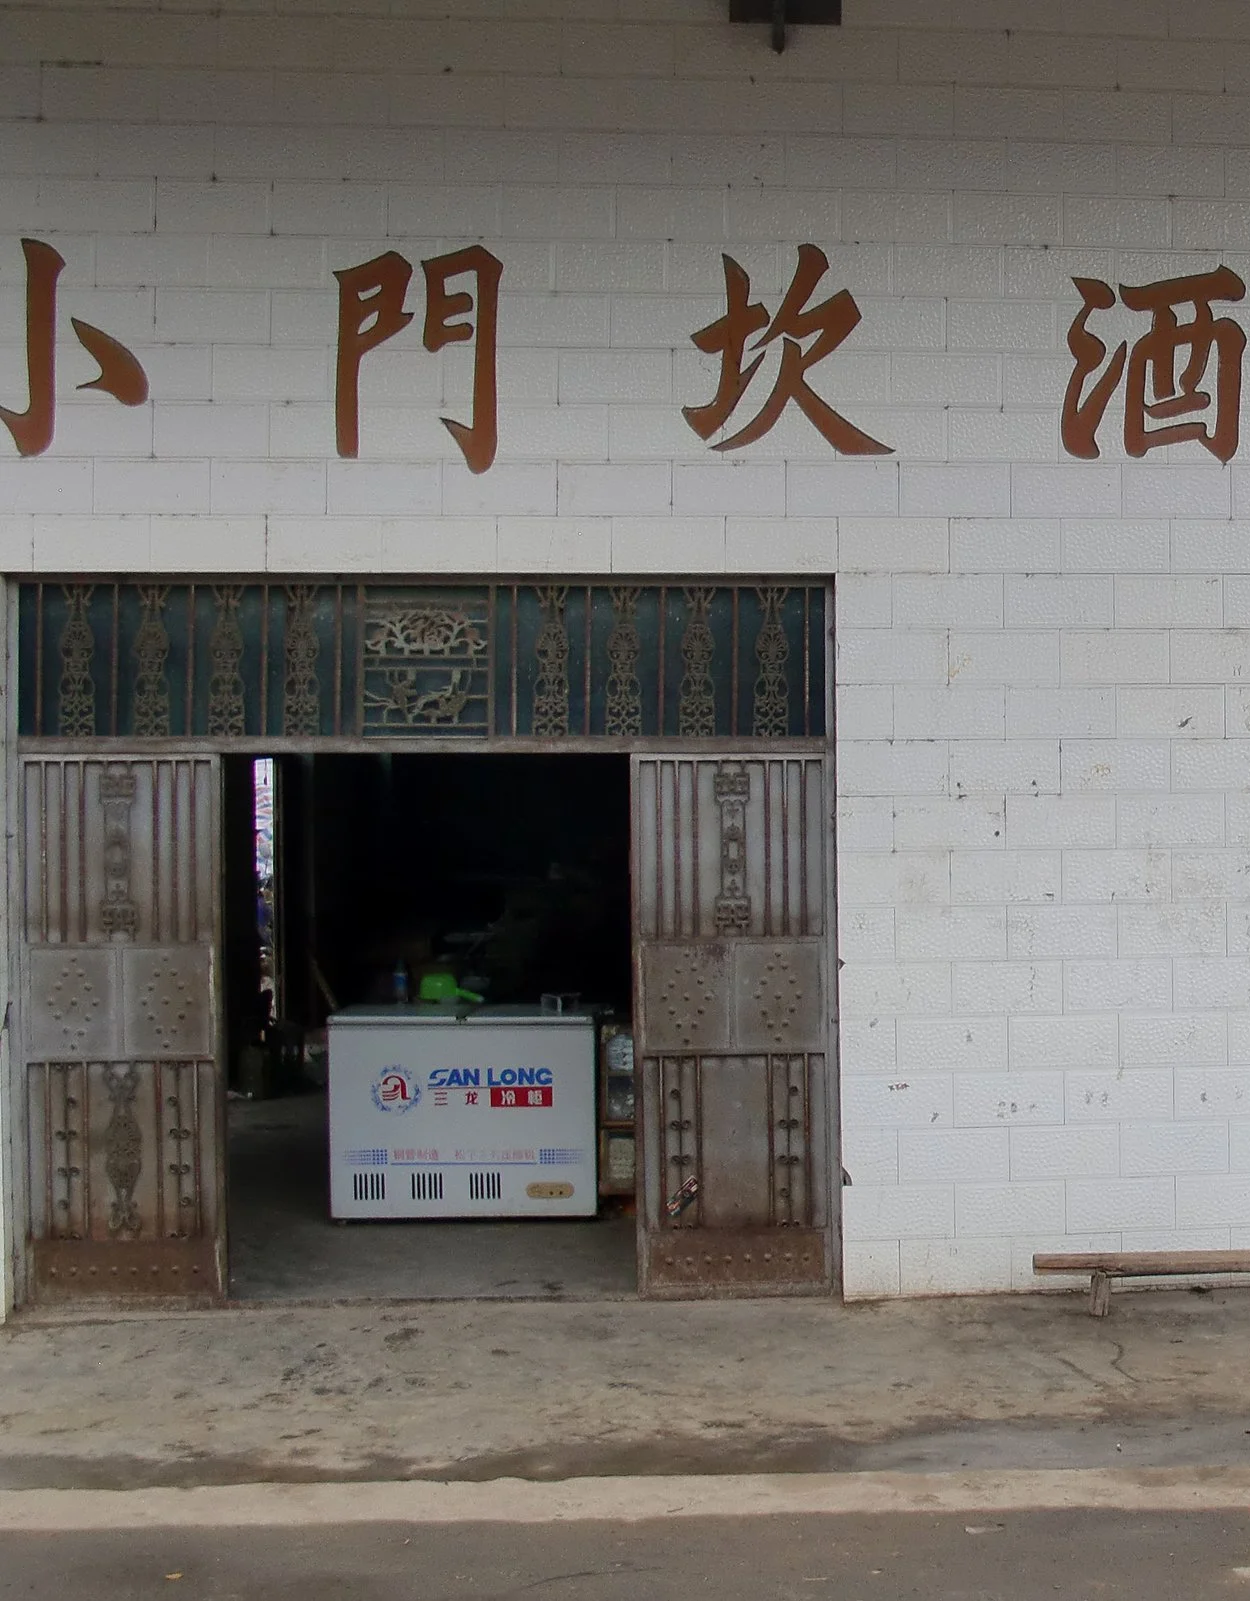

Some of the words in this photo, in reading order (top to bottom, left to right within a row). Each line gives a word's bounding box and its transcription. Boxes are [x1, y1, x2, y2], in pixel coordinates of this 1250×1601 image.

[428, 1068, 480, 1086] SAN
[487, 1068, 553, 1086] LONG
[434, 1090, 479, 1105] 三龙
